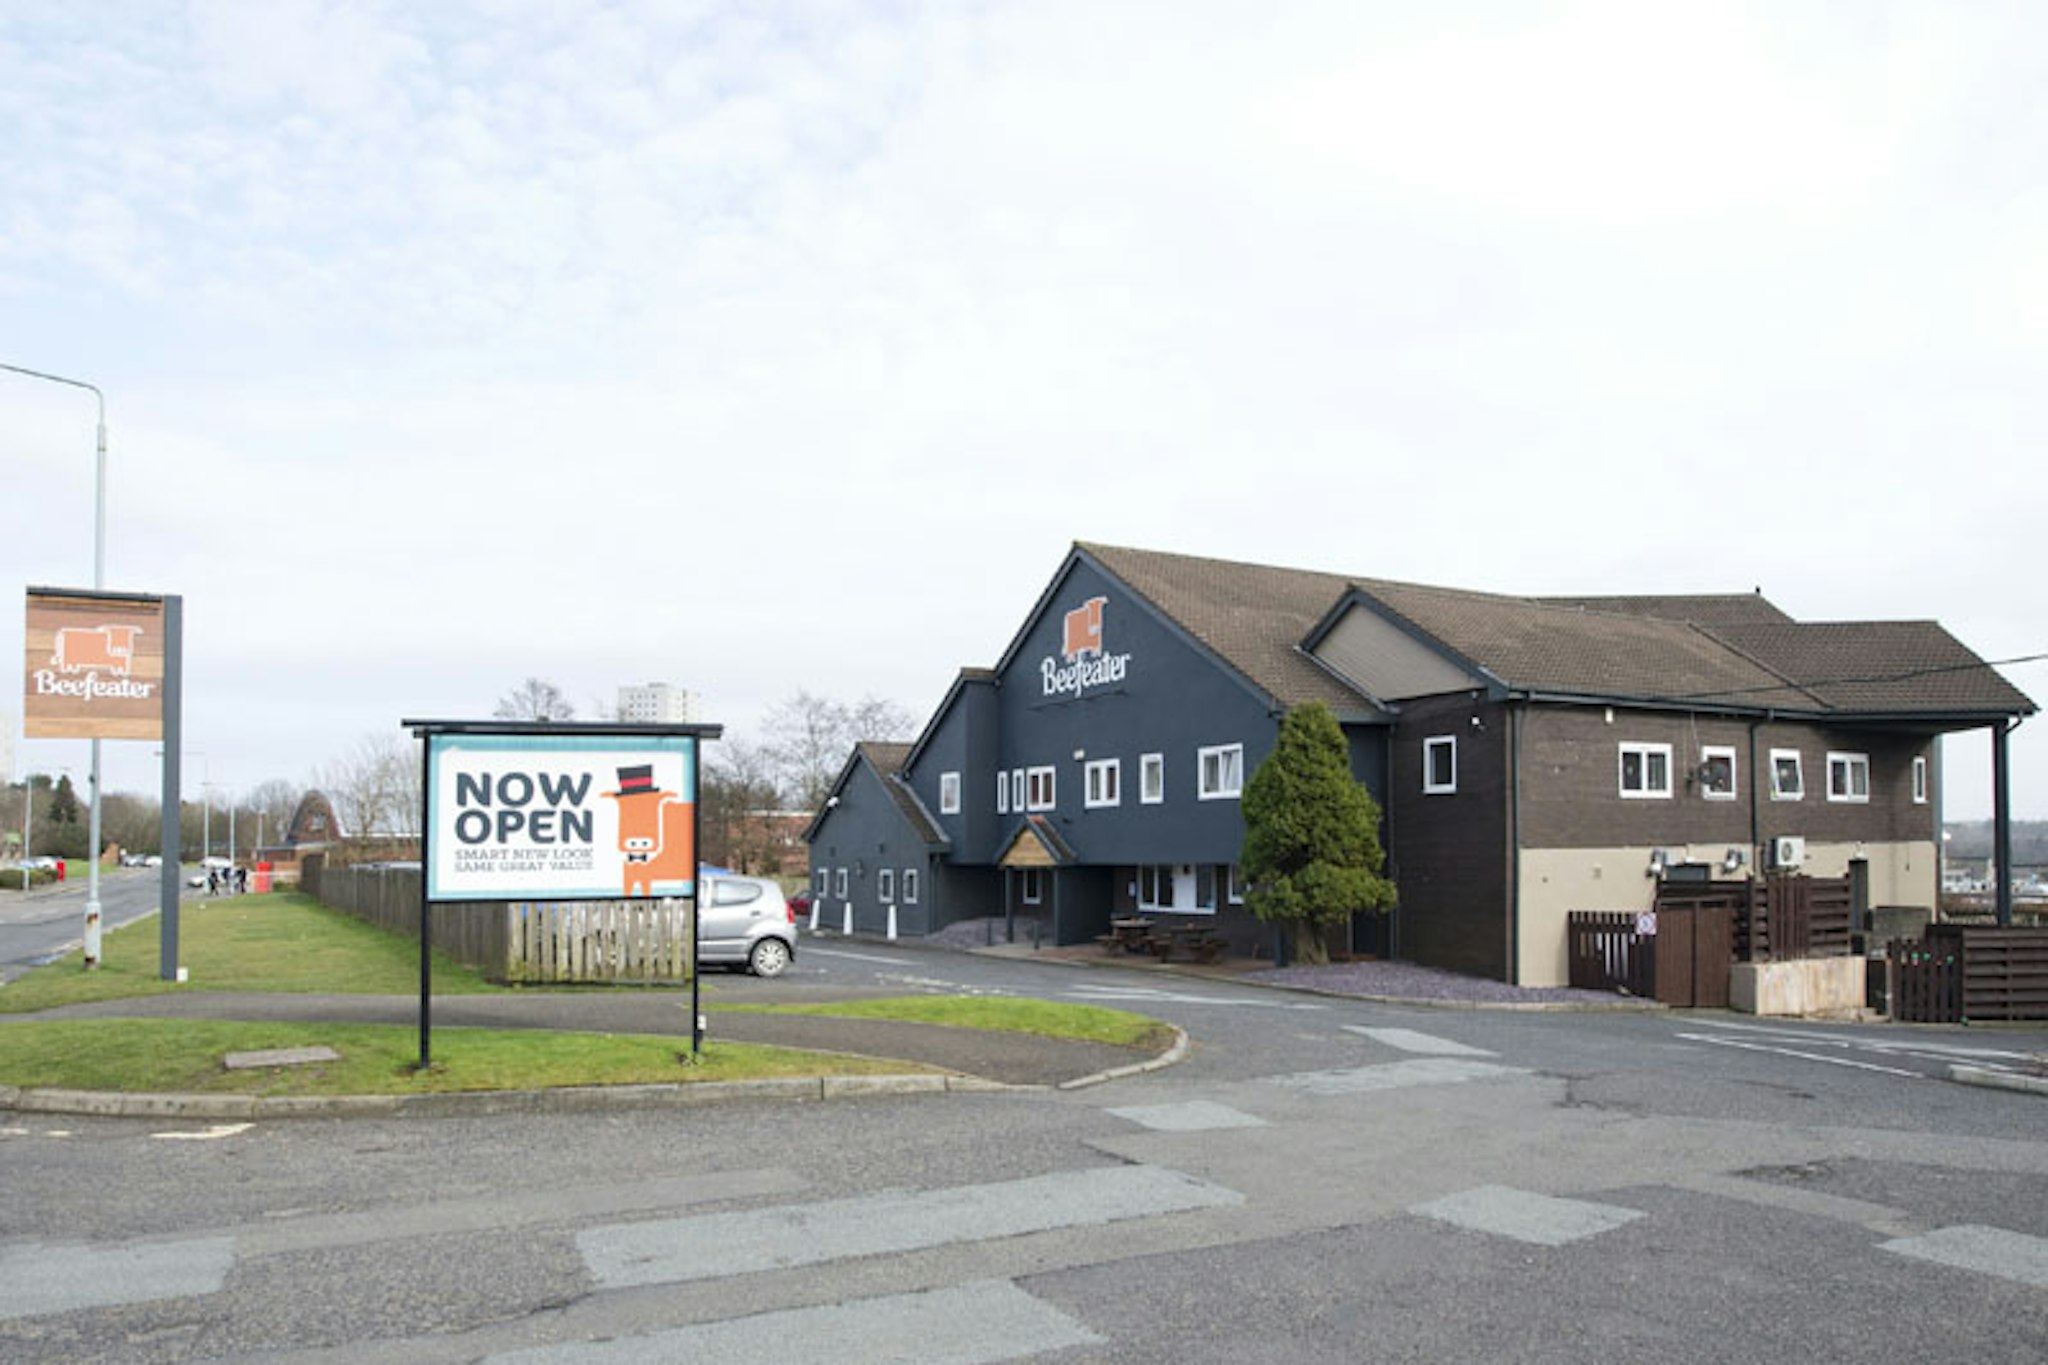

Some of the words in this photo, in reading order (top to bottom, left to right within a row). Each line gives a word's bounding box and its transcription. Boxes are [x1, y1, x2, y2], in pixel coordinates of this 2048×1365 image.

[34, 669, 156, 701] Beefeater
[1040, 652, 1131, 698] Beefeater
[456, 771, 593, 808] NOW
[454, 809, 593, 844] OPEN
[455, 848, 508, 861] SMART
[513, 849, 550, 861] NEW
[554, 849, 593, 860] LOOK
[455, 862, 495, 873] SAME
[499, 862, 544, 872] GREAT
[549, 862, 593, 871] VALUE
